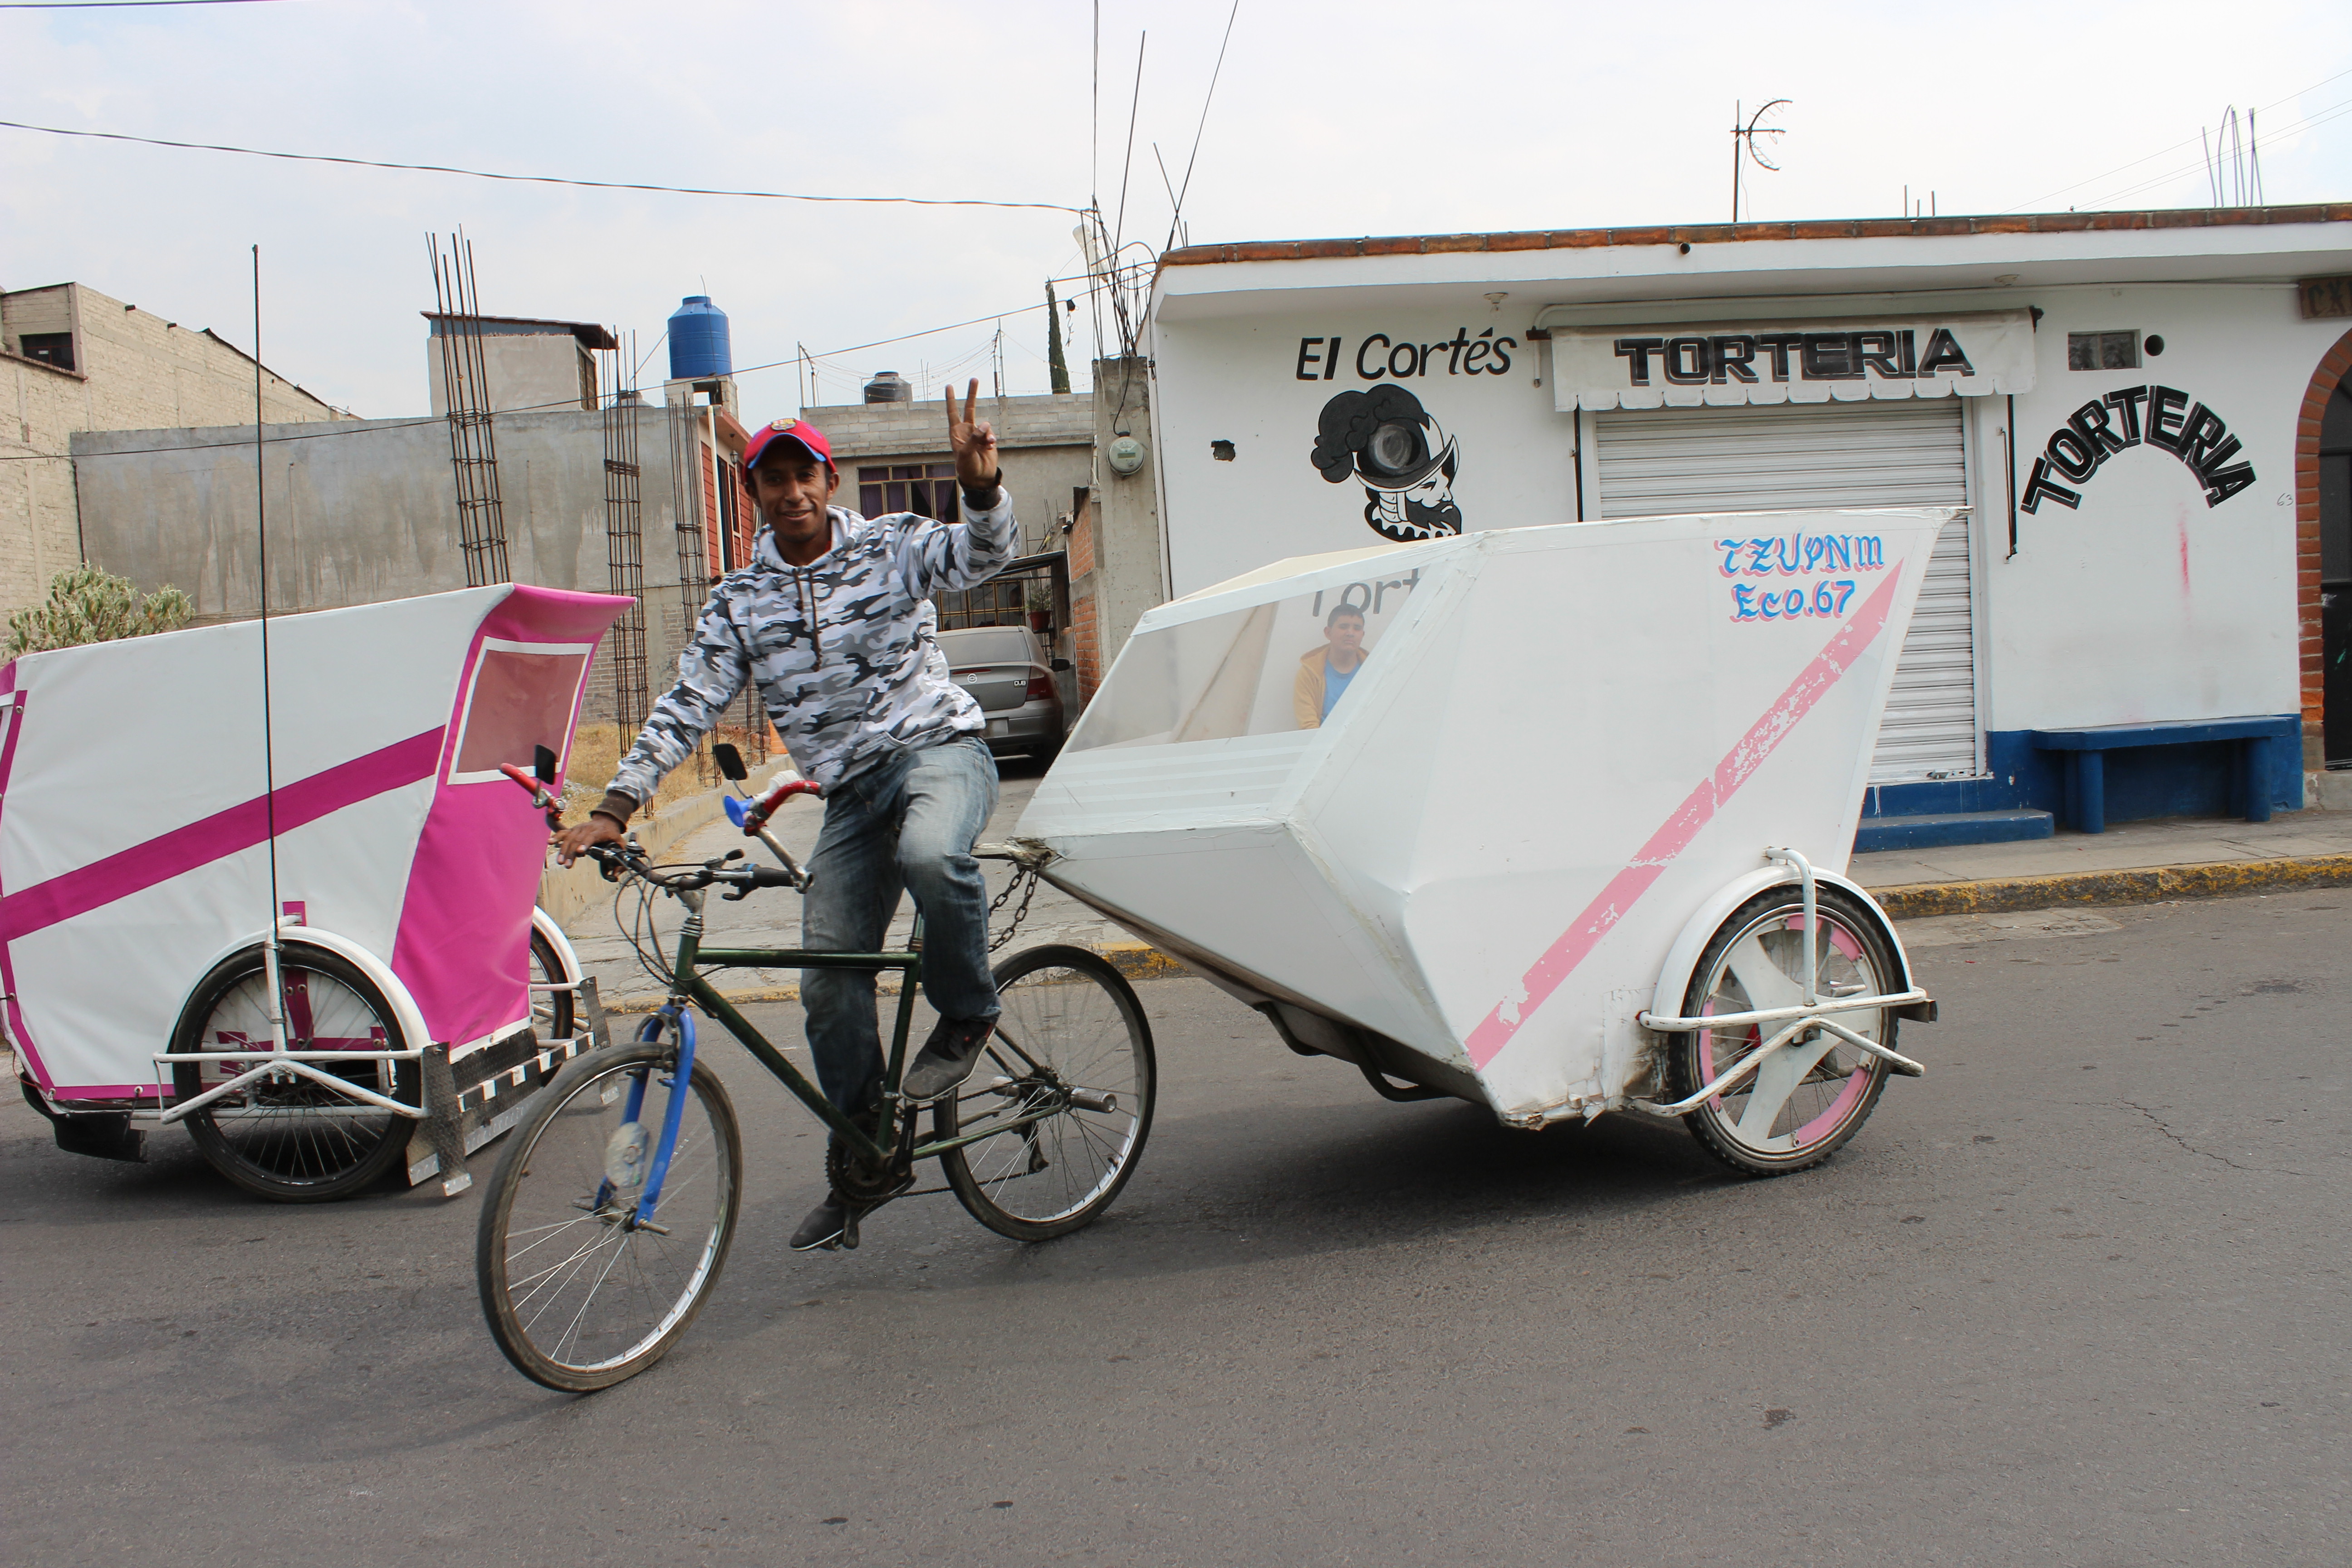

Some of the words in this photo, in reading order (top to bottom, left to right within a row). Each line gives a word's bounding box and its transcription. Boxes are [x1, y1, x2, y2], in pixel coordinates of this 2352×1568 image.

[1356, 327, 1517, 380] Cortés
[1614, 328, 1975, 387] TORTERIA
[2020, 385, 2257, 515] TORTERIA
[2277, 493, 2294, 506] 63
